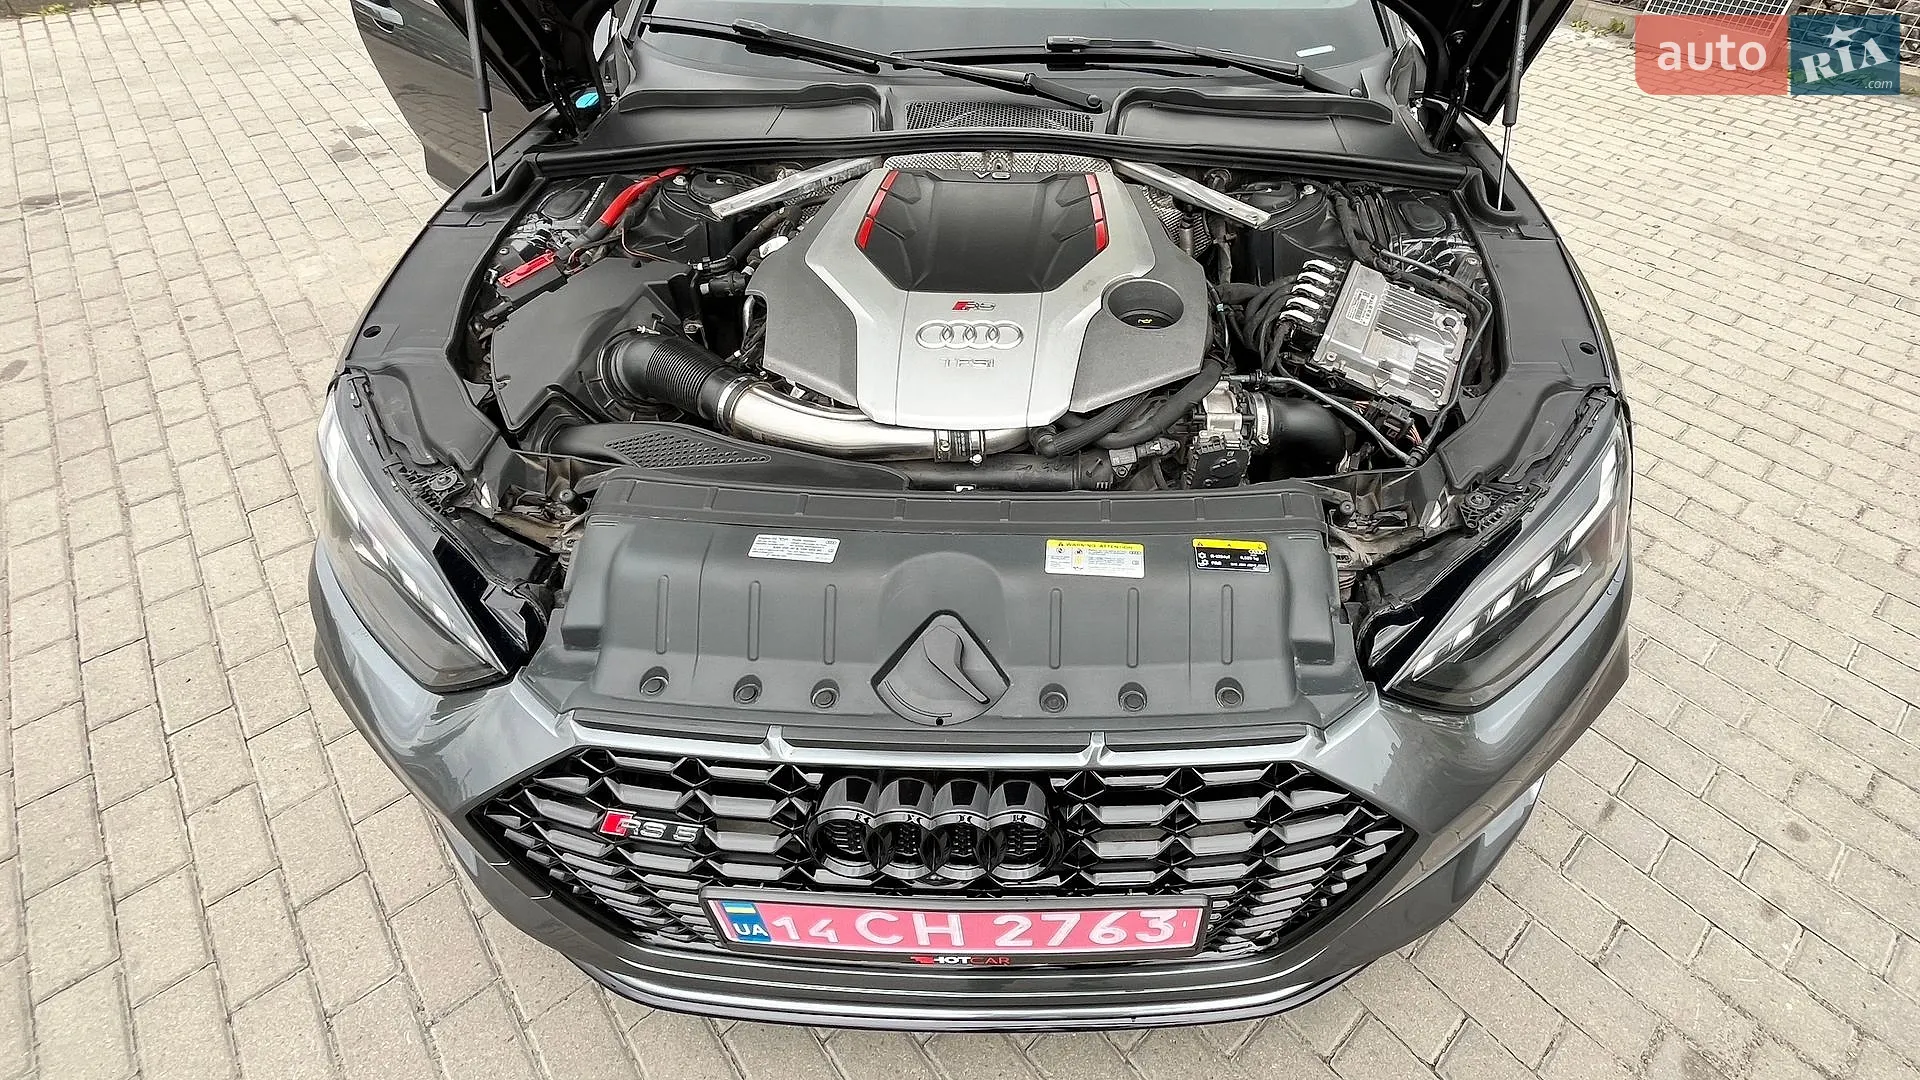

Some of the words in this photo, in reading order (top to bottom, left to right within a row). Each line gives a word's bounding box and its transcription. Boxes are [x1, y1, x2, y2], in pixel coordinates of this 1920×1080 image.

[600, 811, 667, 838] RS
[672, 826, 699, 842] 5
[733, 923, 769, 936] UA
[772, 916, 839, 943] 14
[855, 911, 966, 946] CH
[993, 910, 1178, 947] 2763
